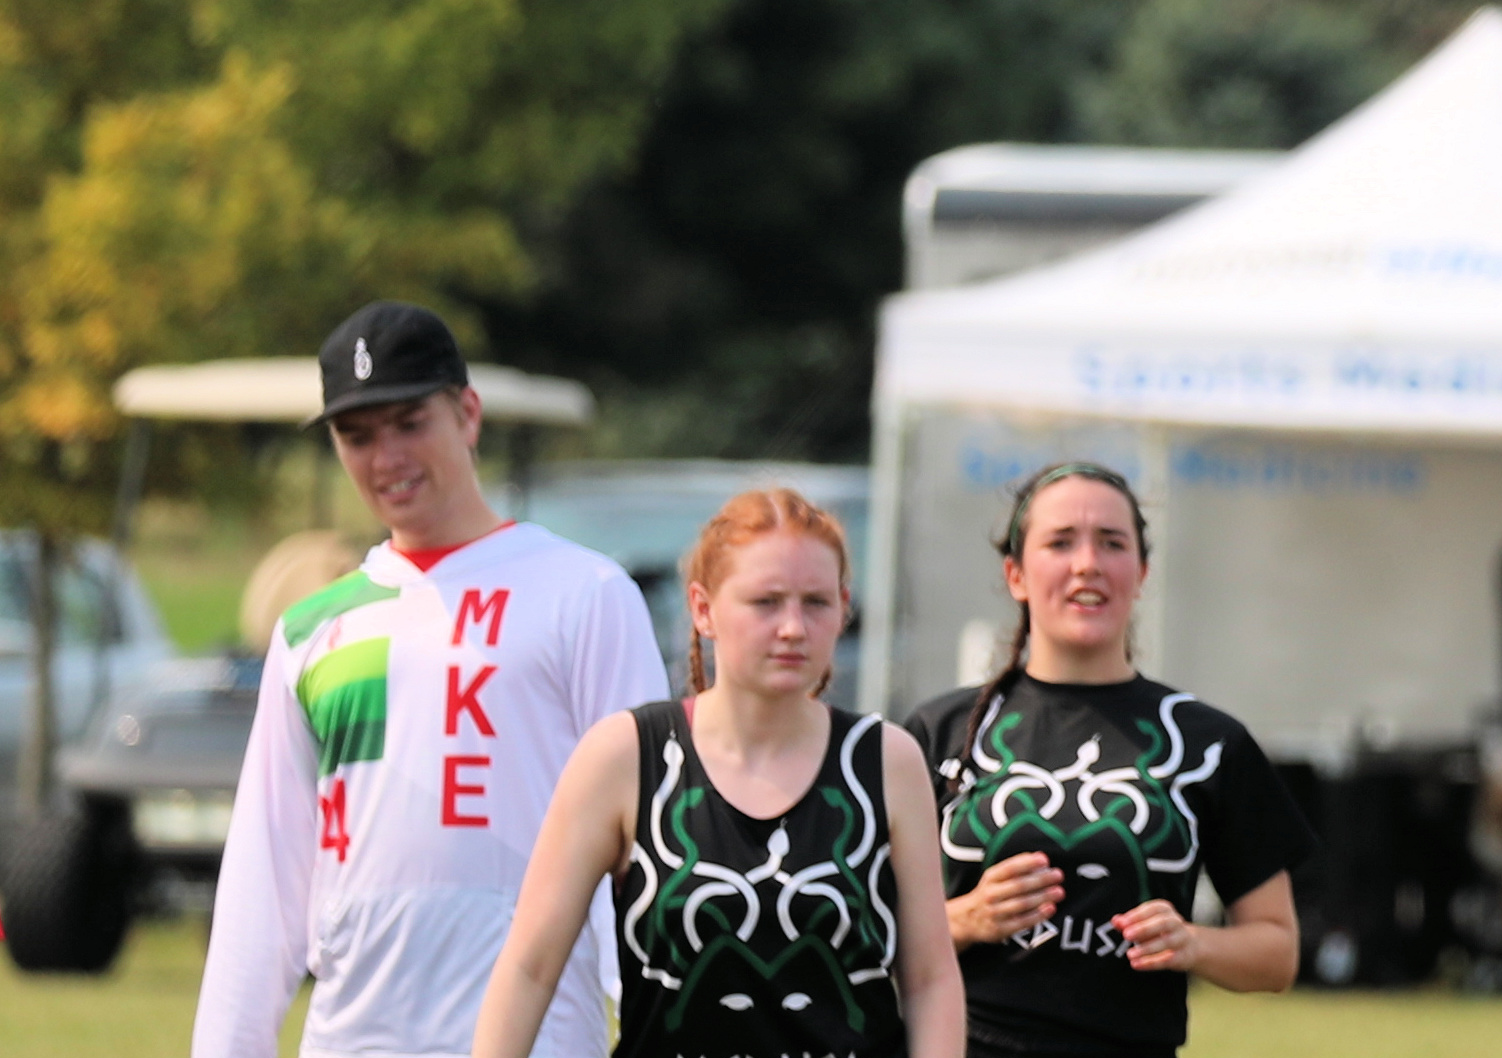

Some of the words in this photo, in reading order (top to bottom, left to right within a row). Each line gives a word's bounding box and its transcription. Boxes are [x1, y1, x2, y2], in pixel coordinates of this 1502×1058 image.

[441, 589, 511, 828] MKE
[319, 777, 351, 863] 4
[1002, 915, 1136, 958] EDUS
